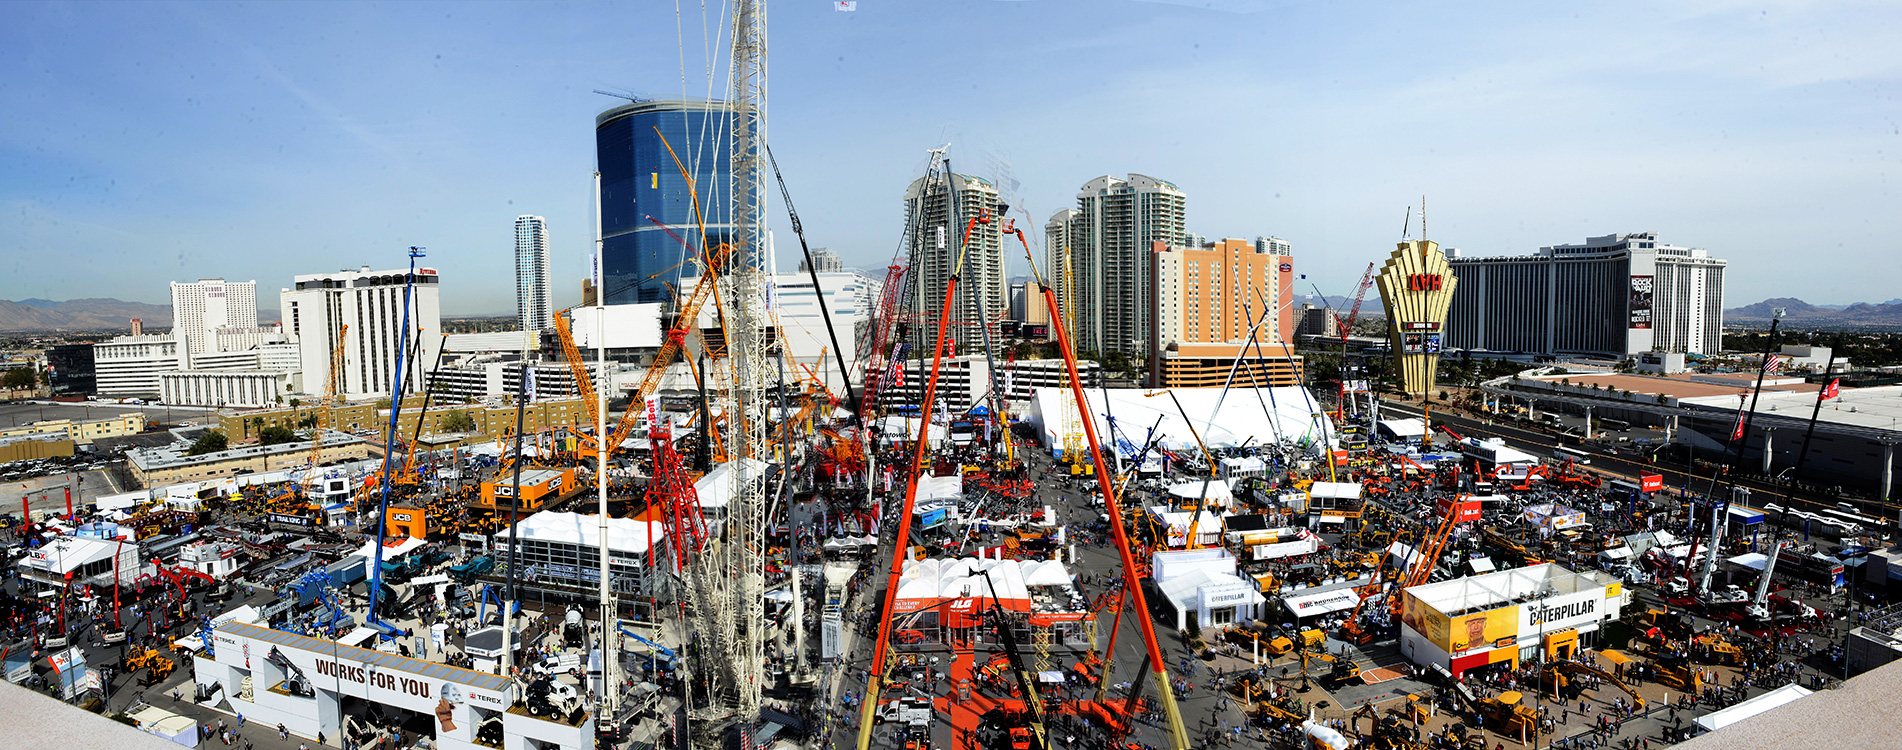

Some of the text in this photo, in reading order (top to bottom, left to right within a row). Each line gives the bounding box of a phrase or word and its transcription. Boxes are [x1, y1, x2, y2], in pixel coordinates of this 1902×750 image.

[1411, 274, 1441, 290] LVH
[548, 476, 562, 491] JCB
[392, 513, 411, 522] JCB
[30, 551, 46, 561] LBX
[617, 558, 638, 566] TEREX
[950, 599, 973, 609] JLG
[1529, 599, 1595, 627] CATERPILLAR
[315, 658, 433, 700] WORKS FOR YOU.
[477, 694, 502, 704] TEREX
